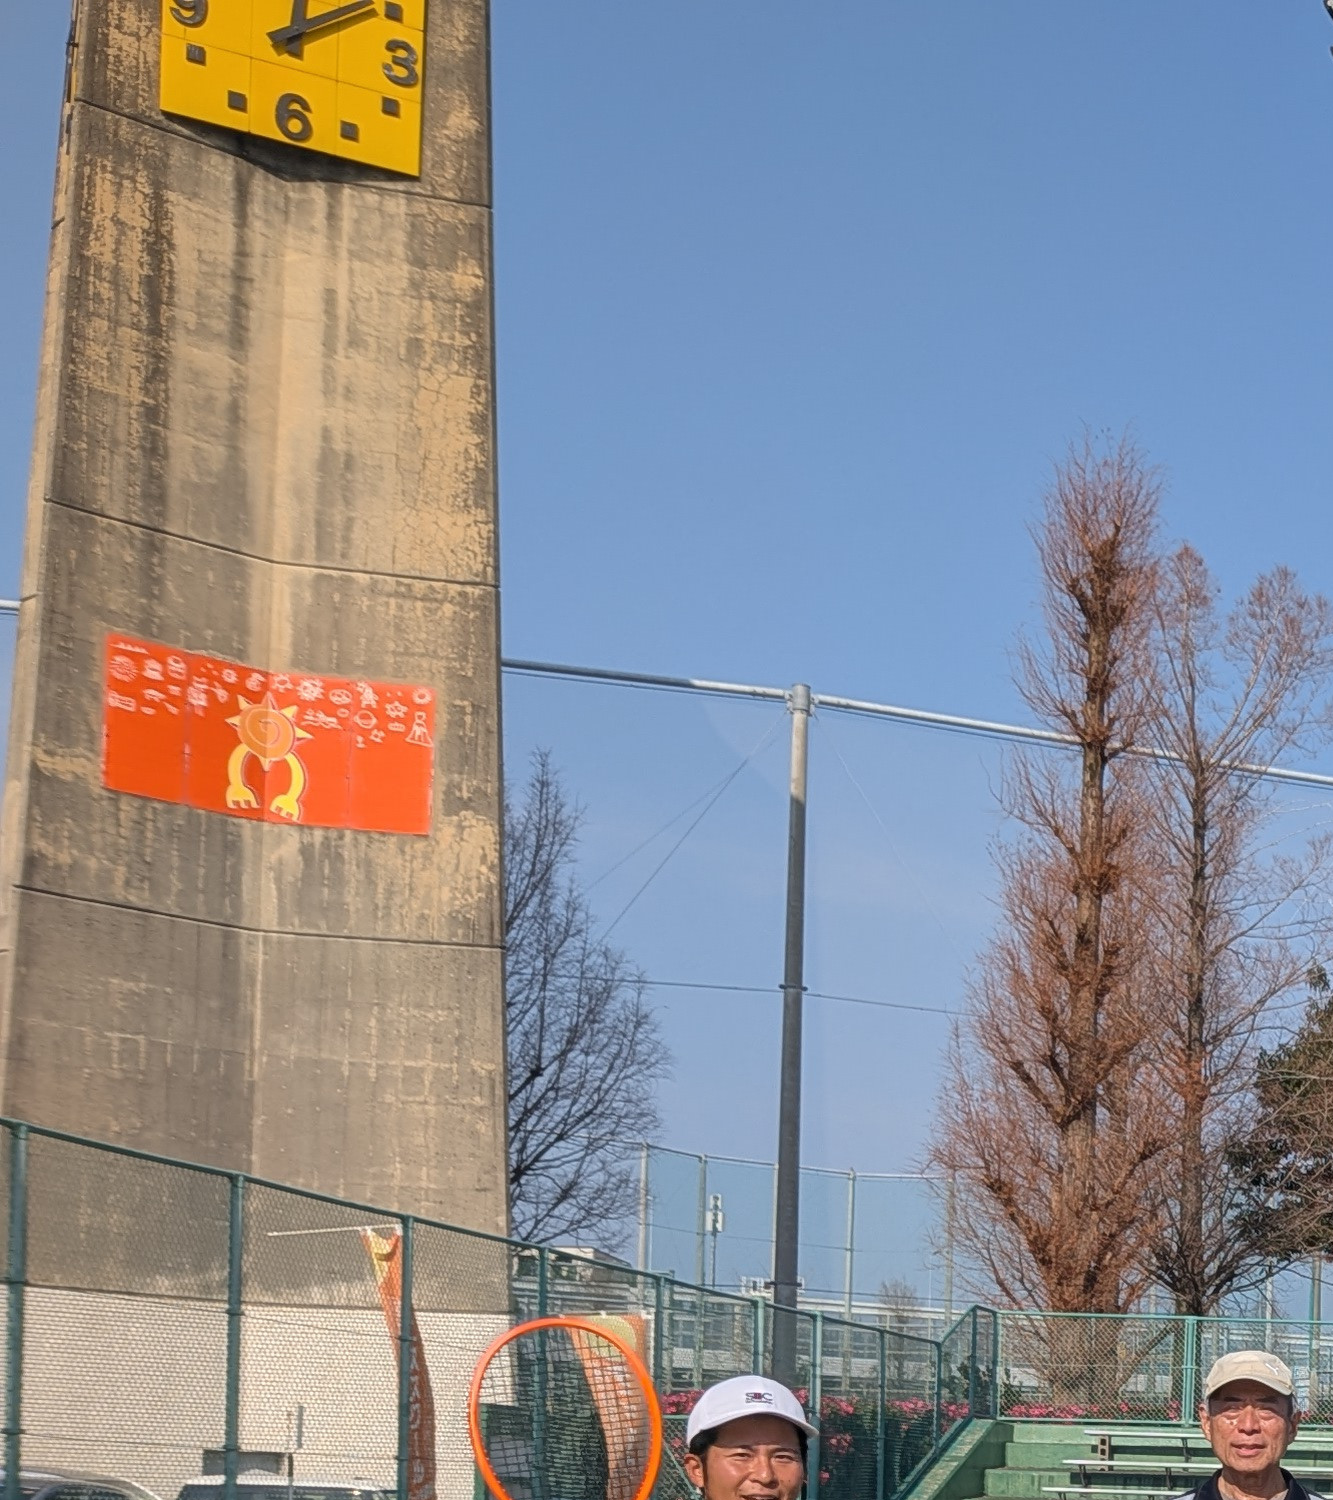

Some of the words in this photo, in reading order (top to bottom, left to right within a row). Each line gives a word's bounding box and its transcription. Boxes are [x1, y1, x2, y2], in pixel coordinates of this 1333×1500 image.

[169, 0, 208, 28] 9
[382, 39, 418, 87] 3
[275, 93, 313, 141] 6
